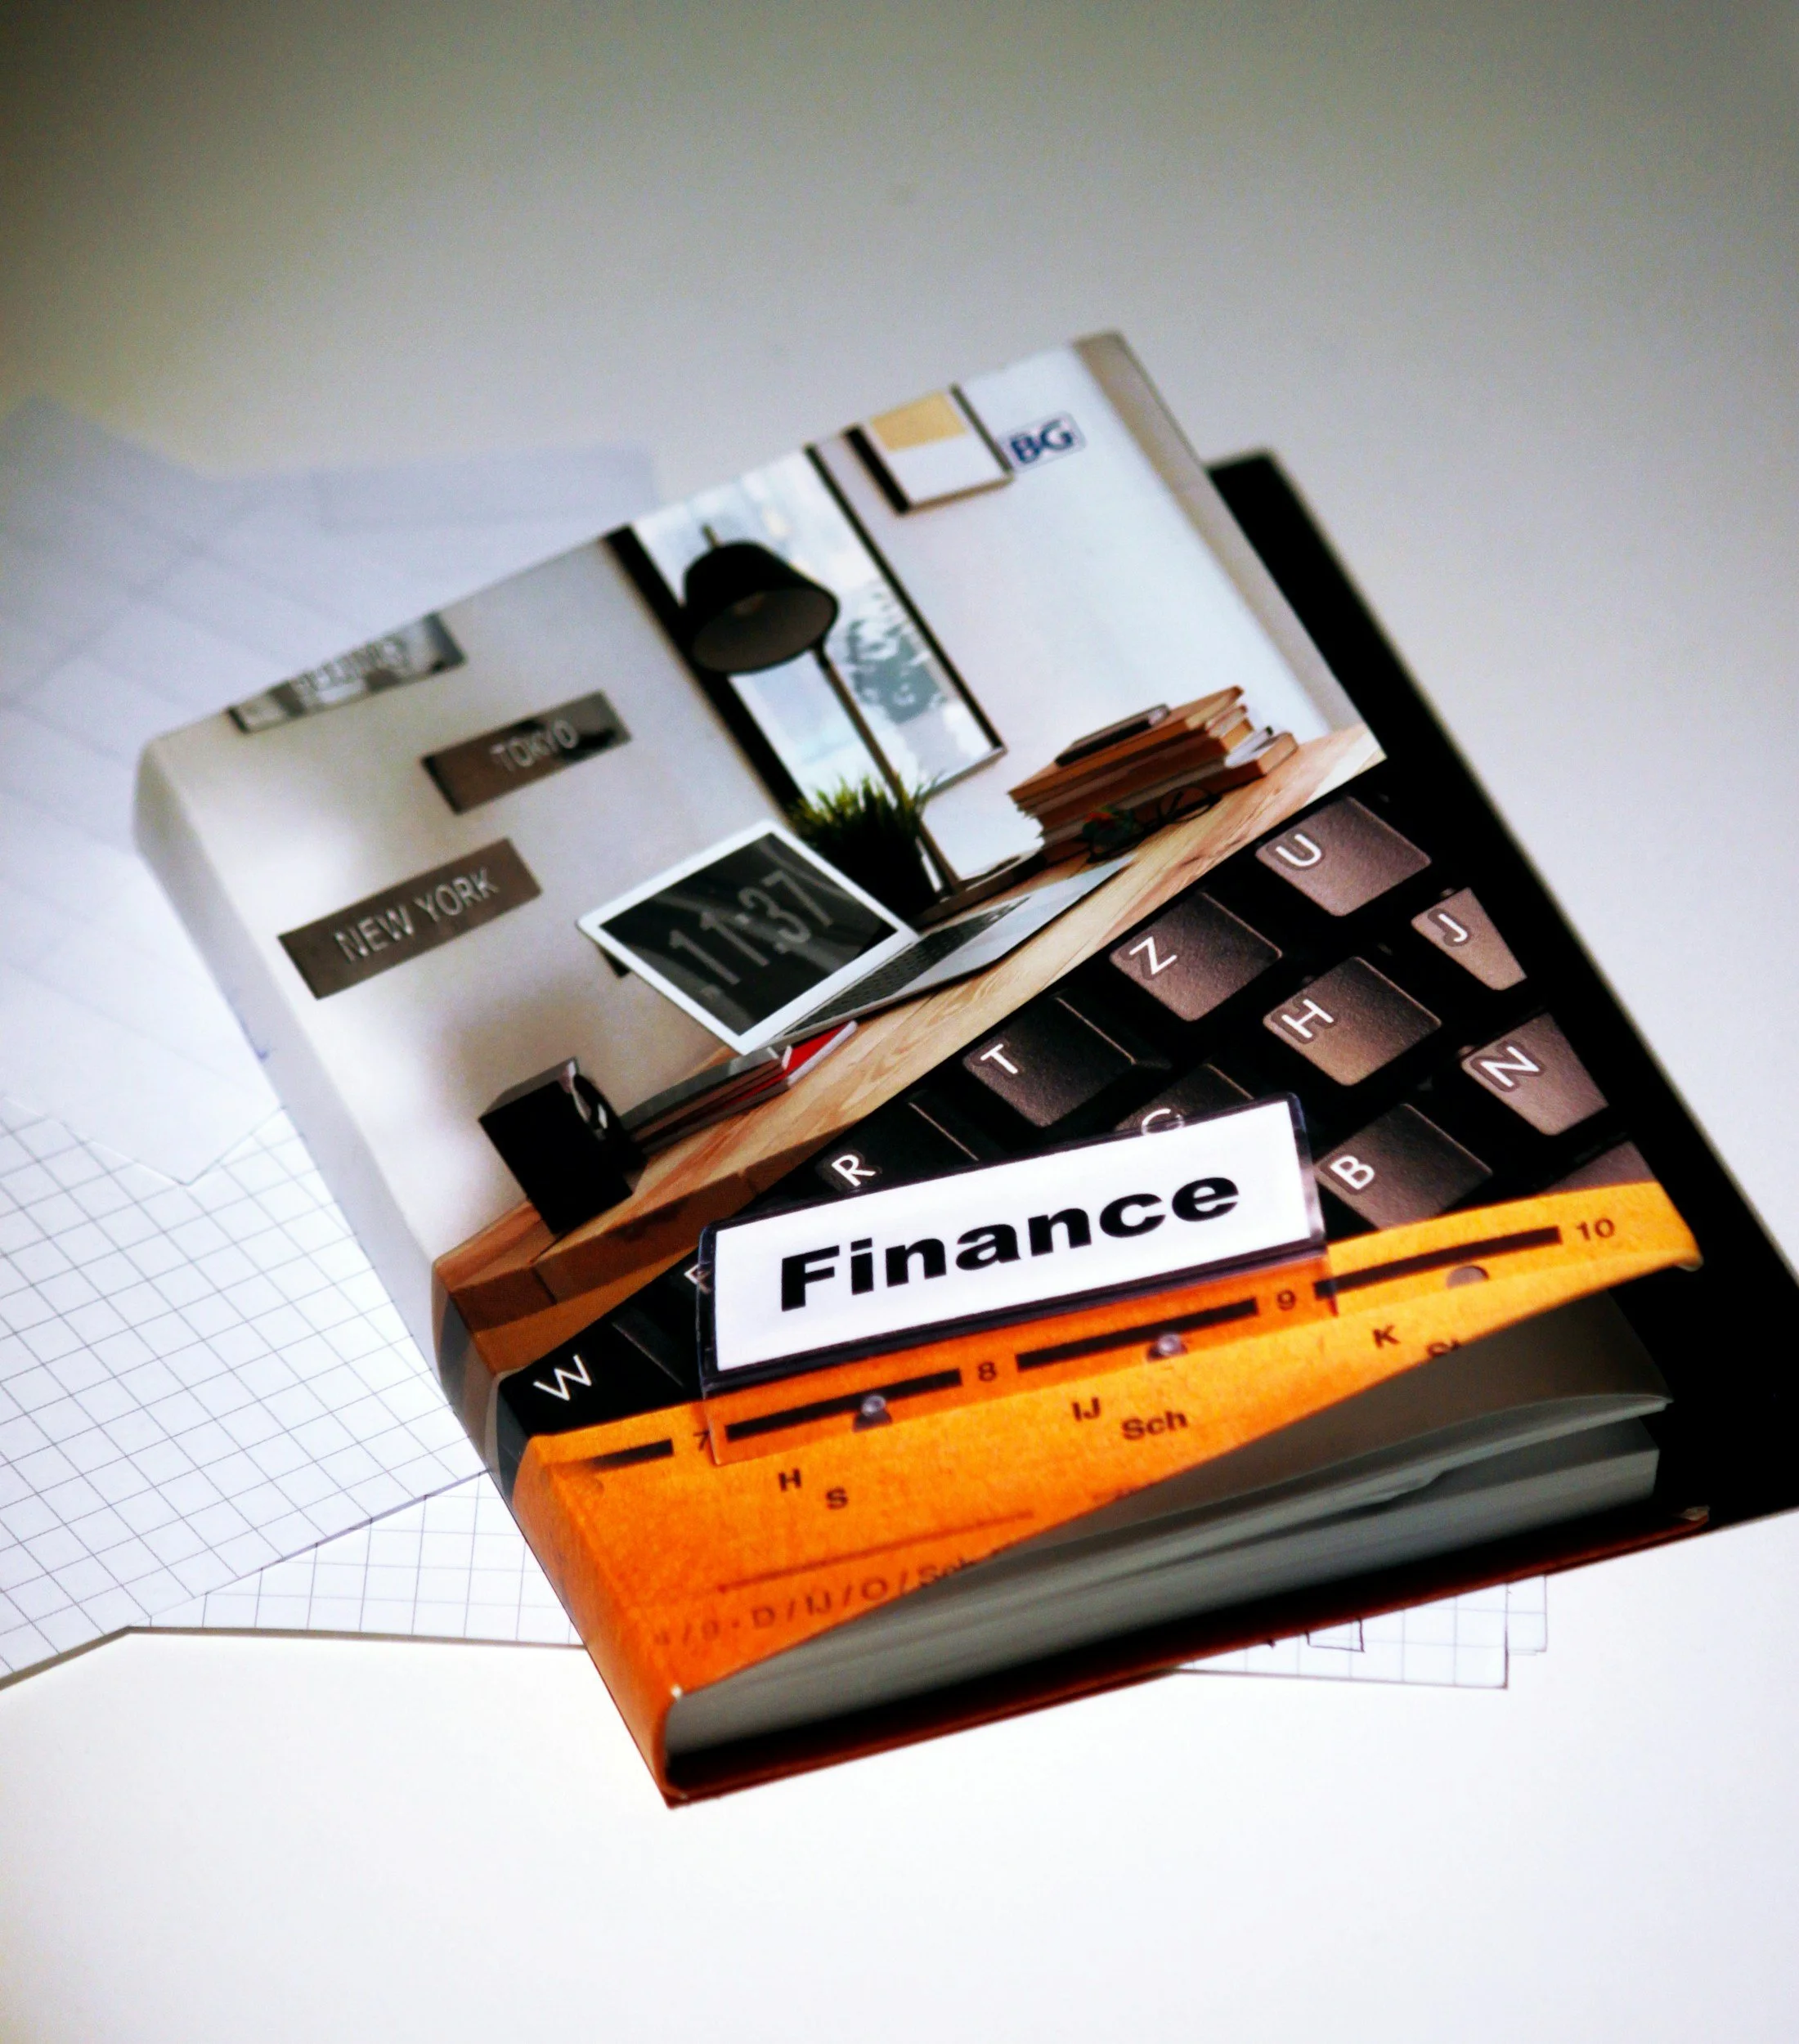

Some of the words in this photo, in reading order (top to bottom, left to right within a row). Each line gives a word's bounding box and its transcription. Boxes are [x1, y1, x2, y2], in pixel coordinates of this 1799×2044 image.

[1010, 419, 1074, 464] BG
[491, 719, 578, 771] TOKYO
[1276, 834, 1321, 867] U
[334, 905, 415, 963] NEW
[414, 867, 500, 923] YORK
[669, 870, 833, 984] 11:37
[1437, 913, 1469, 944] J
[1129, 936, 1177, 975] Z
[1281, 999, 1334, 1038] H
[980, 1043, 1019, 1074] T
[1480, 1046, 1541, 1088] N
[831, 1154, 875, 1186] R
[1330, 1155, 1375, 1190] B
[780, 1175, 1240, 1312] Finance
[976, 1362, 998, 1382] 8
[1276, 1290, 1297, 1311] 9
[1576, 1217, 1616, 1241] 10
[533, 1355, 594, 1401] W
[778, 1469, 802, 1491] H
[1372, 1325, 1400, 1348] K
[825, 1488, 849, 1510] S
[1120, 1410, 1189, 1441] Sch
